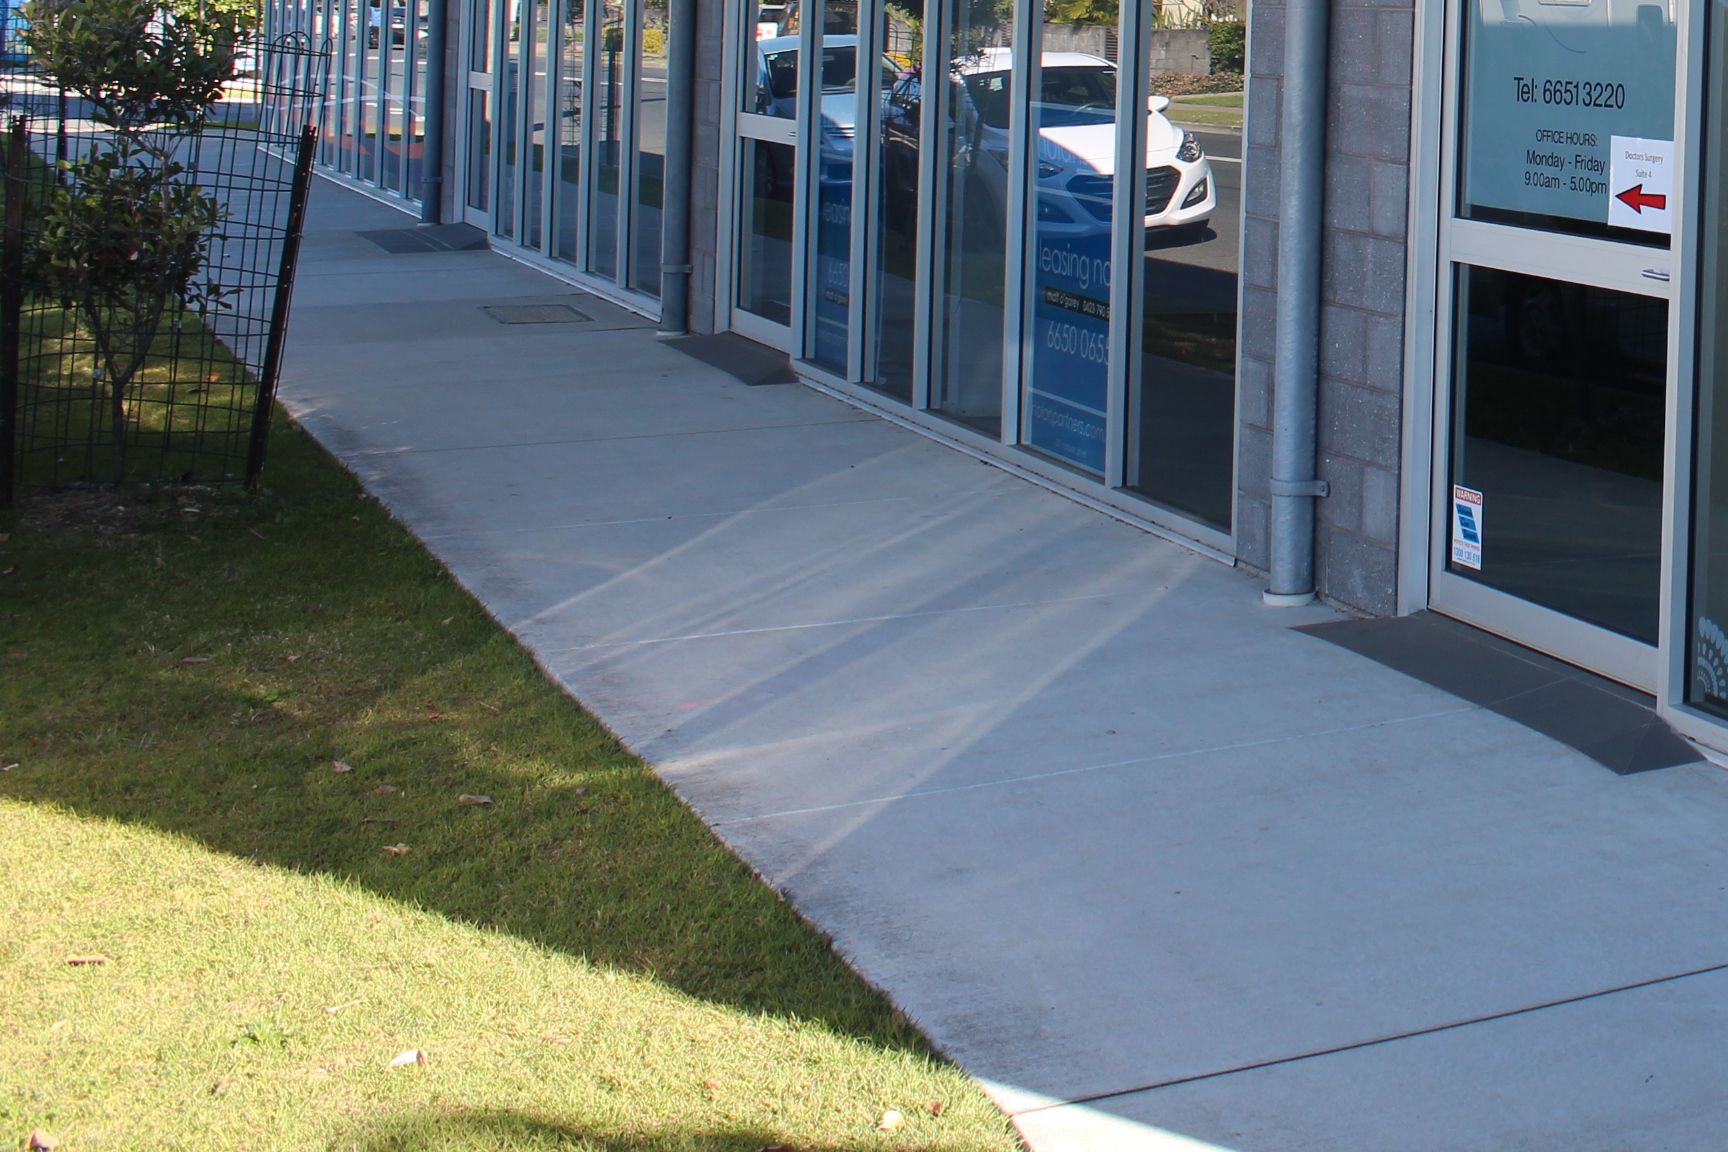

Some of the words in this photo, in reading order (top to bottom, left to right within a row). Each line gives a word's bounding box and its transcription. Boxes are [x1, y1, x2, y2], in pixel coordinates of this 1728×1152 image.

[1514, 77, 1538, 103] Tel:
[1543, 79, 1625, 109] 66513220
[1536, 129, 1564, 144] OFFICE
[1526, 150, 1565, 171] Monday
[1575, 155, 1606, 176] Friday
[1525, 171, 1560, 189] 9.00am
[1570, 176, 1607, 196] 5.00pm
[1039, 237, 1090, 289] leasing
[1047, 320, 1078, 355] 6650
[1456, 489, 1481, 505] WARNING
